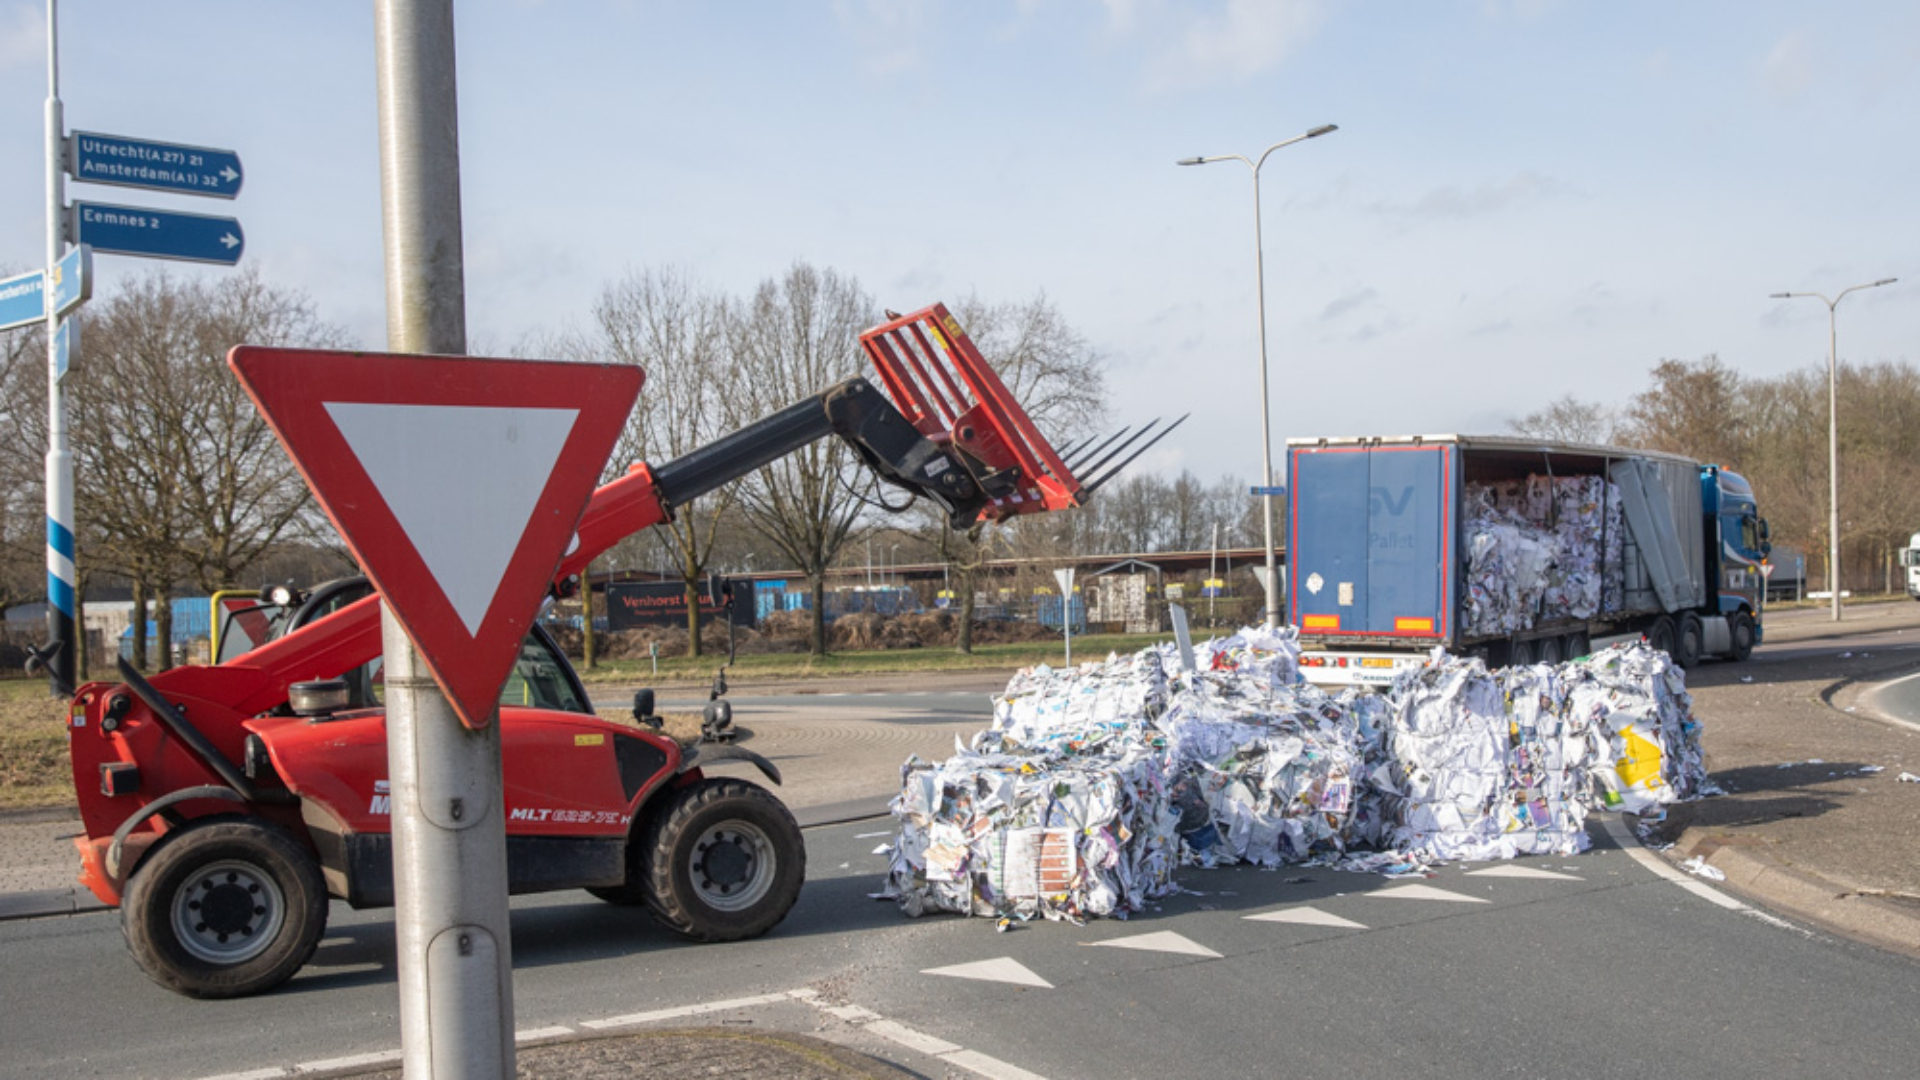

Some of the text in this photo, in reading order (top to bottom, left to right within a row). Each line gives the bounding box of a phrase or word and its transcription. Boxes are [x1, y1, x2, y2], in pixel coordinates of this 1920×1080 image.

[189, 155, 203, 166] 21
[203, 175, 218, 187] 32
[84, 208, 160, 229] Eemnes 2
[622, 594, 680, 608] Venhorst
[510, 808, 552, 821] MLT
